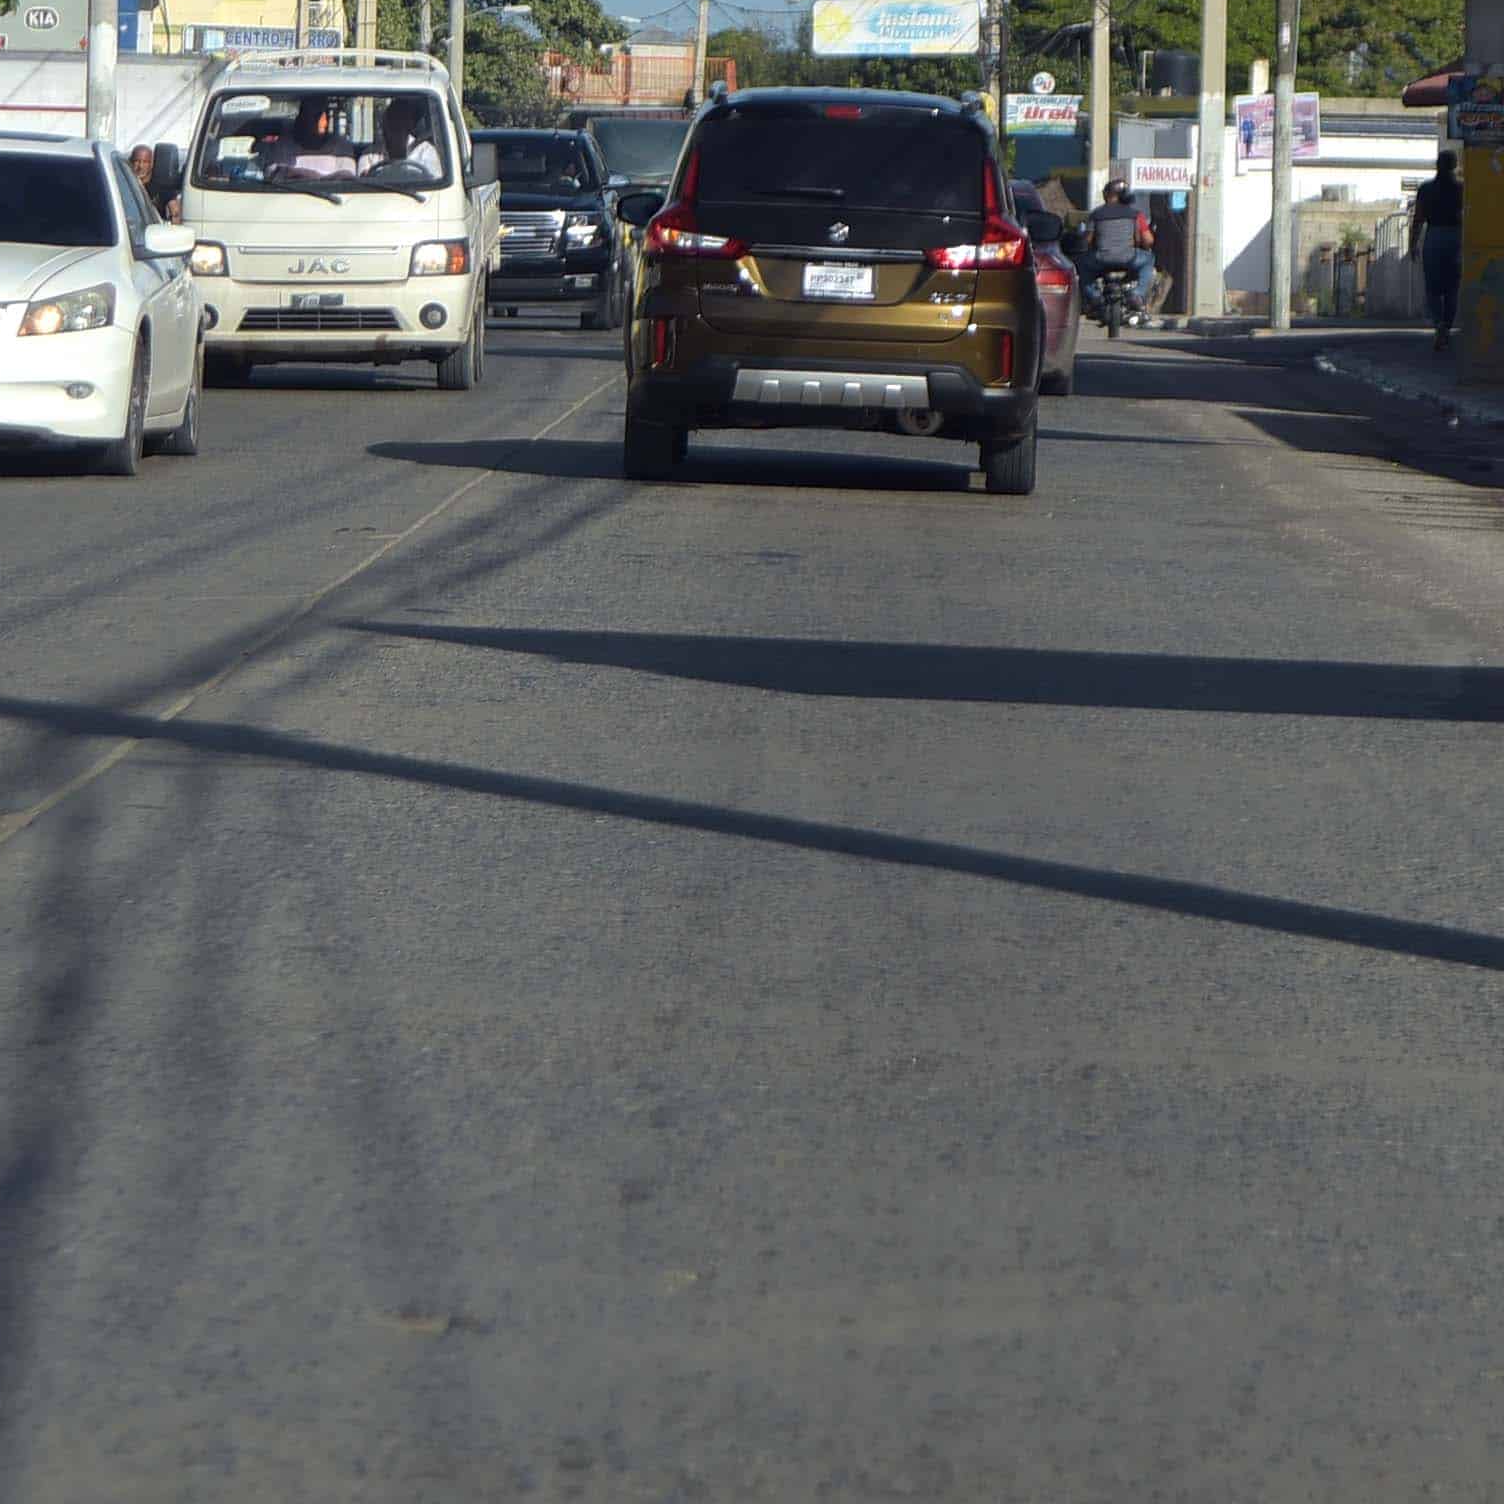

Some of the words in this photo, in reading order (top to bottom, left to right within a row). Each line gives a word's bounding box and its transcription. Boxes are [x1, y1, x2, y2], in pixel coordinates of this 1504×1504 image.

[28, 11, 56, 26] KIA
[225, 29, 280, 45] CENTRO
[1137, 166, 1189, 183] FARMACIA
[287, 256, 352, 274] JAC
